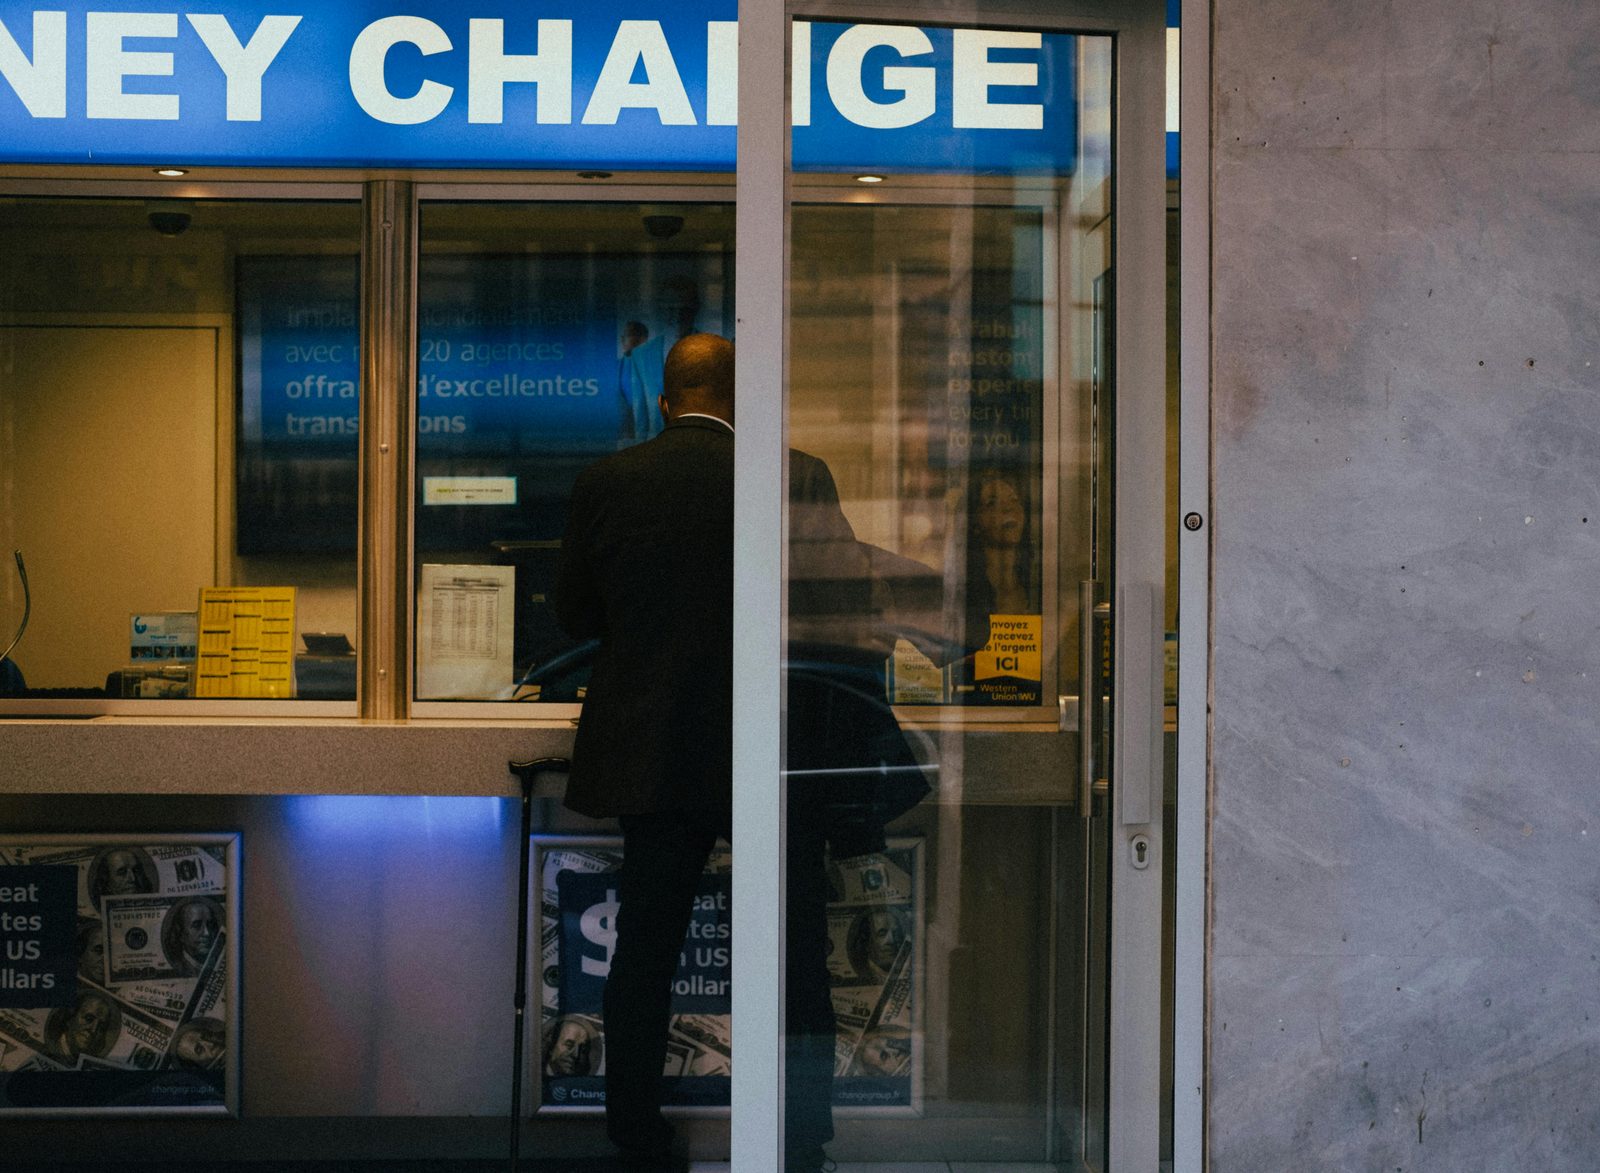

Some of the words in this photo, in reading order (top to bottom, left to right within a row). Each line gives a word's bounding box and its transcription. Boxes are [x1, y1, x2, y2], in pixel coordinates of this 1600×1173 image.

[0, 10, 303, 122] NEY
[285, 344, 343, 364] avec
[459, 341, 565, 368] agences
[982, 430, 1020, 453] you
[995, 657, 1020, 671] ICI
[979, 684, 1018, 693] Western
[6, 938, 42, 961] US
[695, 947, 729, 968] US
